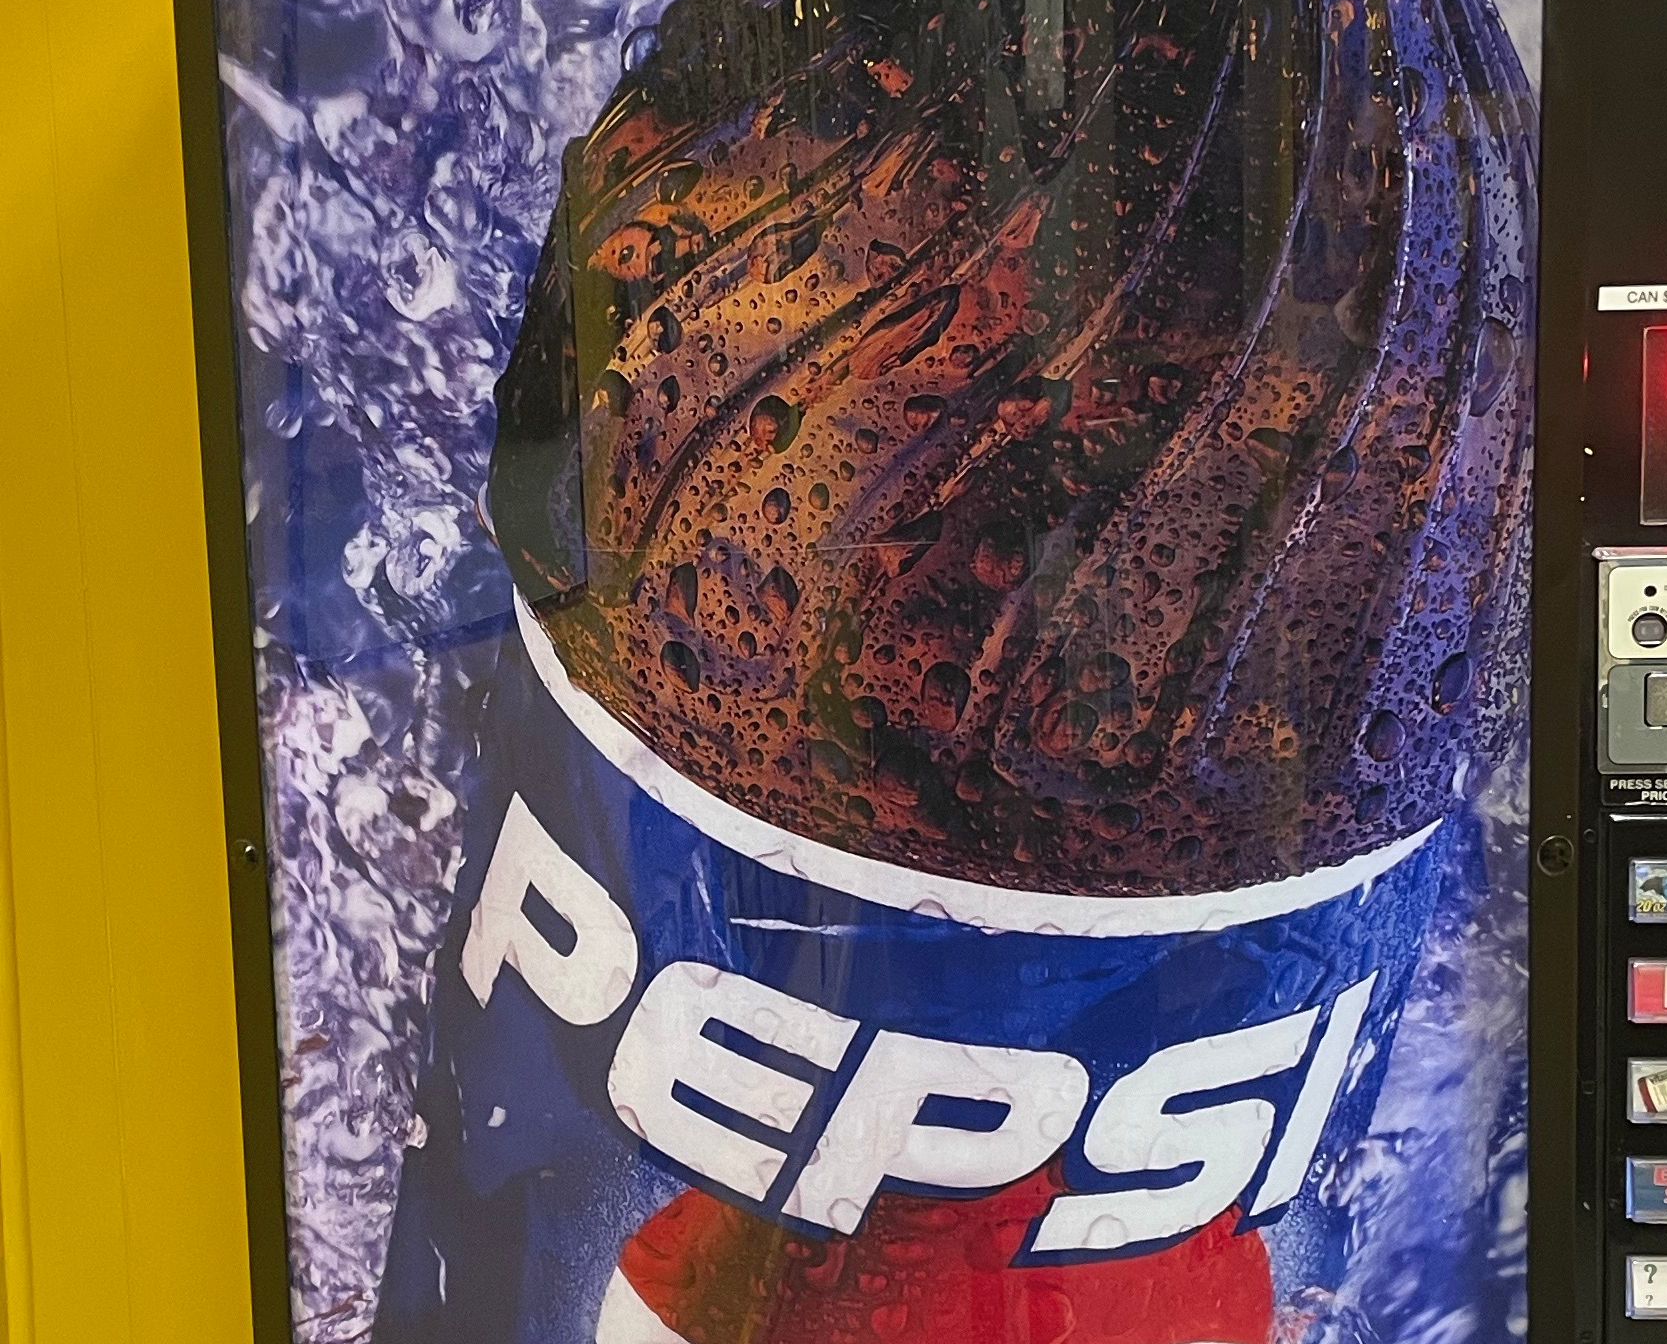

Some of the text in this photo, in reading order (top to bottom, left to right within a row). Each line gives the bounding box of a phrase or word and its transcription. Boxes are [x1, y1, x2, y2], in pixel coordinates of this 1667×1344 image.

[1627, 291, 1658, 304] CAN
[1610, 779, 1652, 790] PRESS
[462, 792, 1378, 1256] PEPSI
